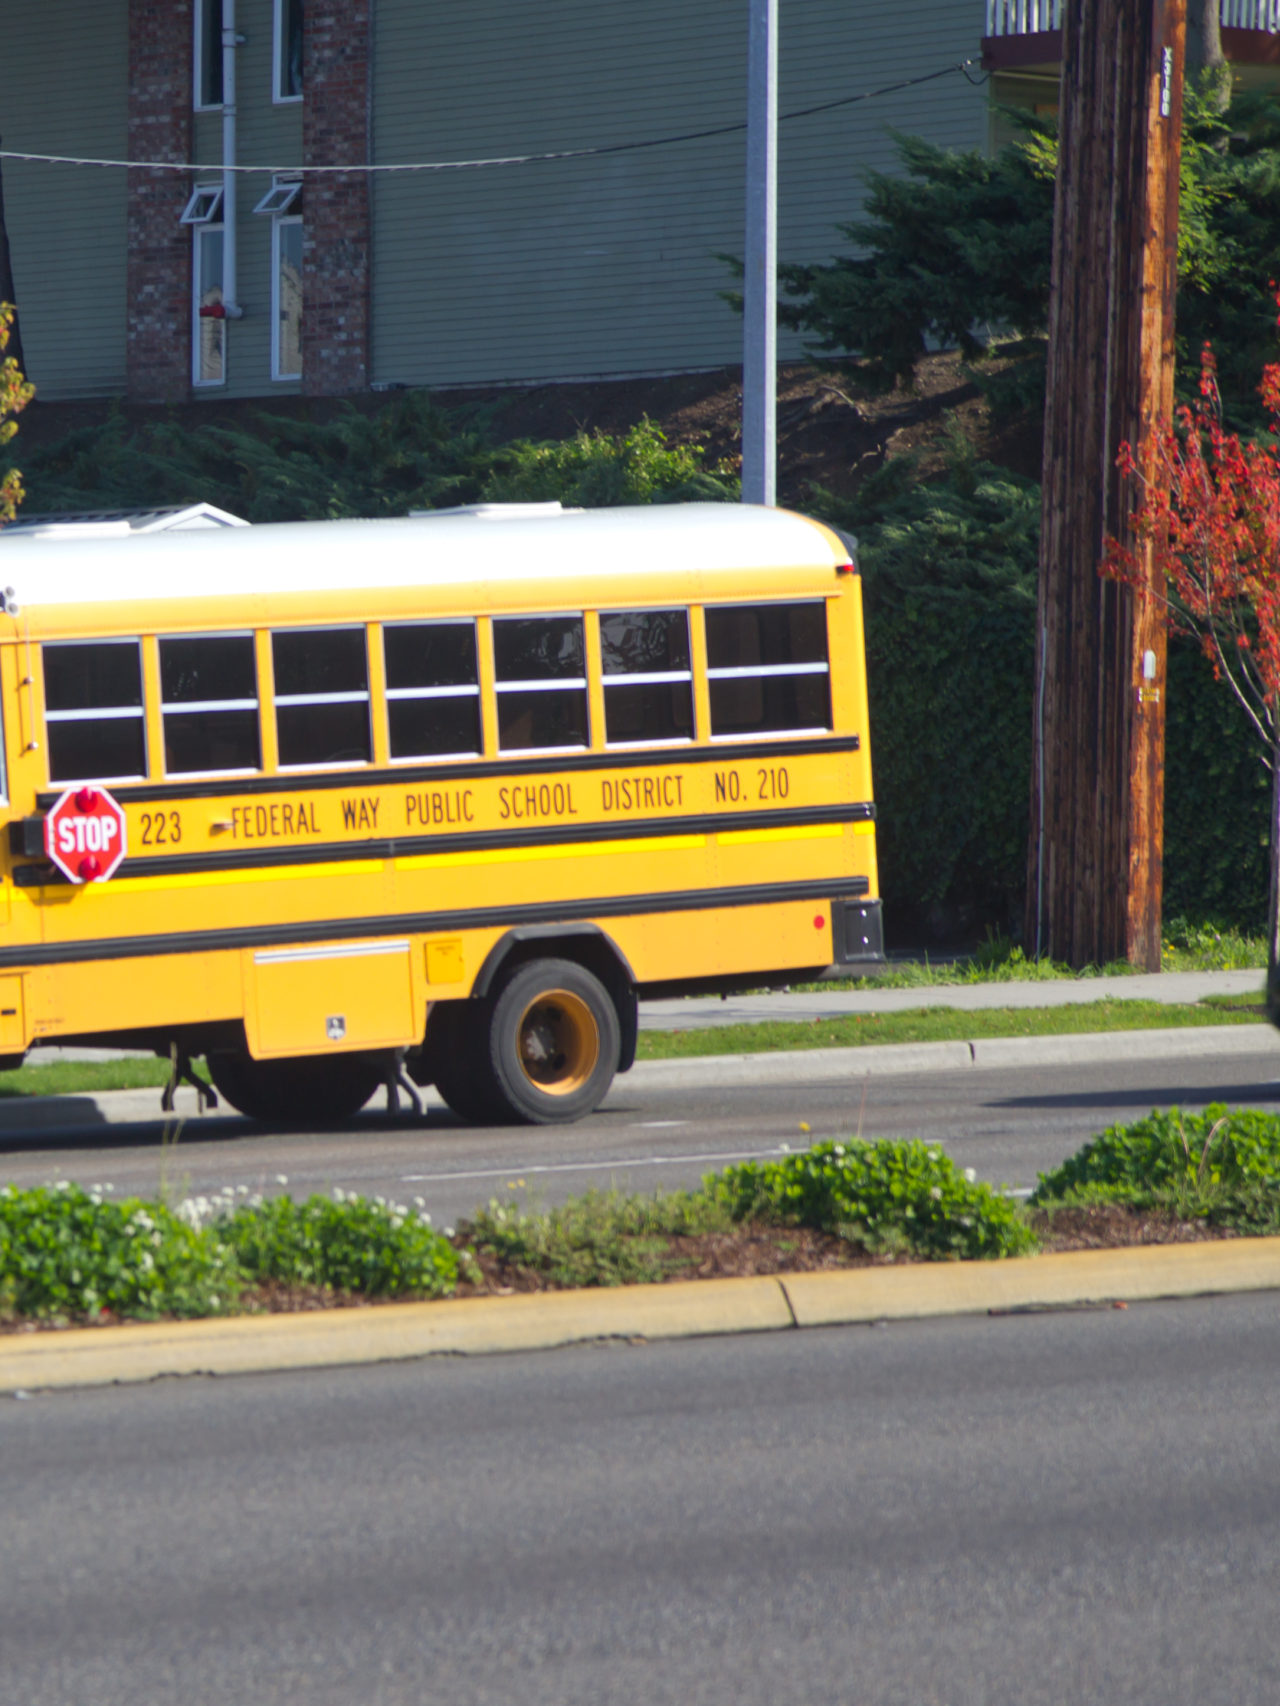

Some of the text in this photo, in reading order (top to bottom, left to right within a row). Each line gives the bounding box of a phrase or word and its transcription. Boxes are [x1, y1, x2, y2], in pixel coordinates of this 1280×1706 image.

[231, 767, 790, 839] FEDERAL WAY PUBLIC SCHOOL DISTRICT NO. 210
[58, 815, 118, 853] STOP
[141, 811, 182, 846] 223
